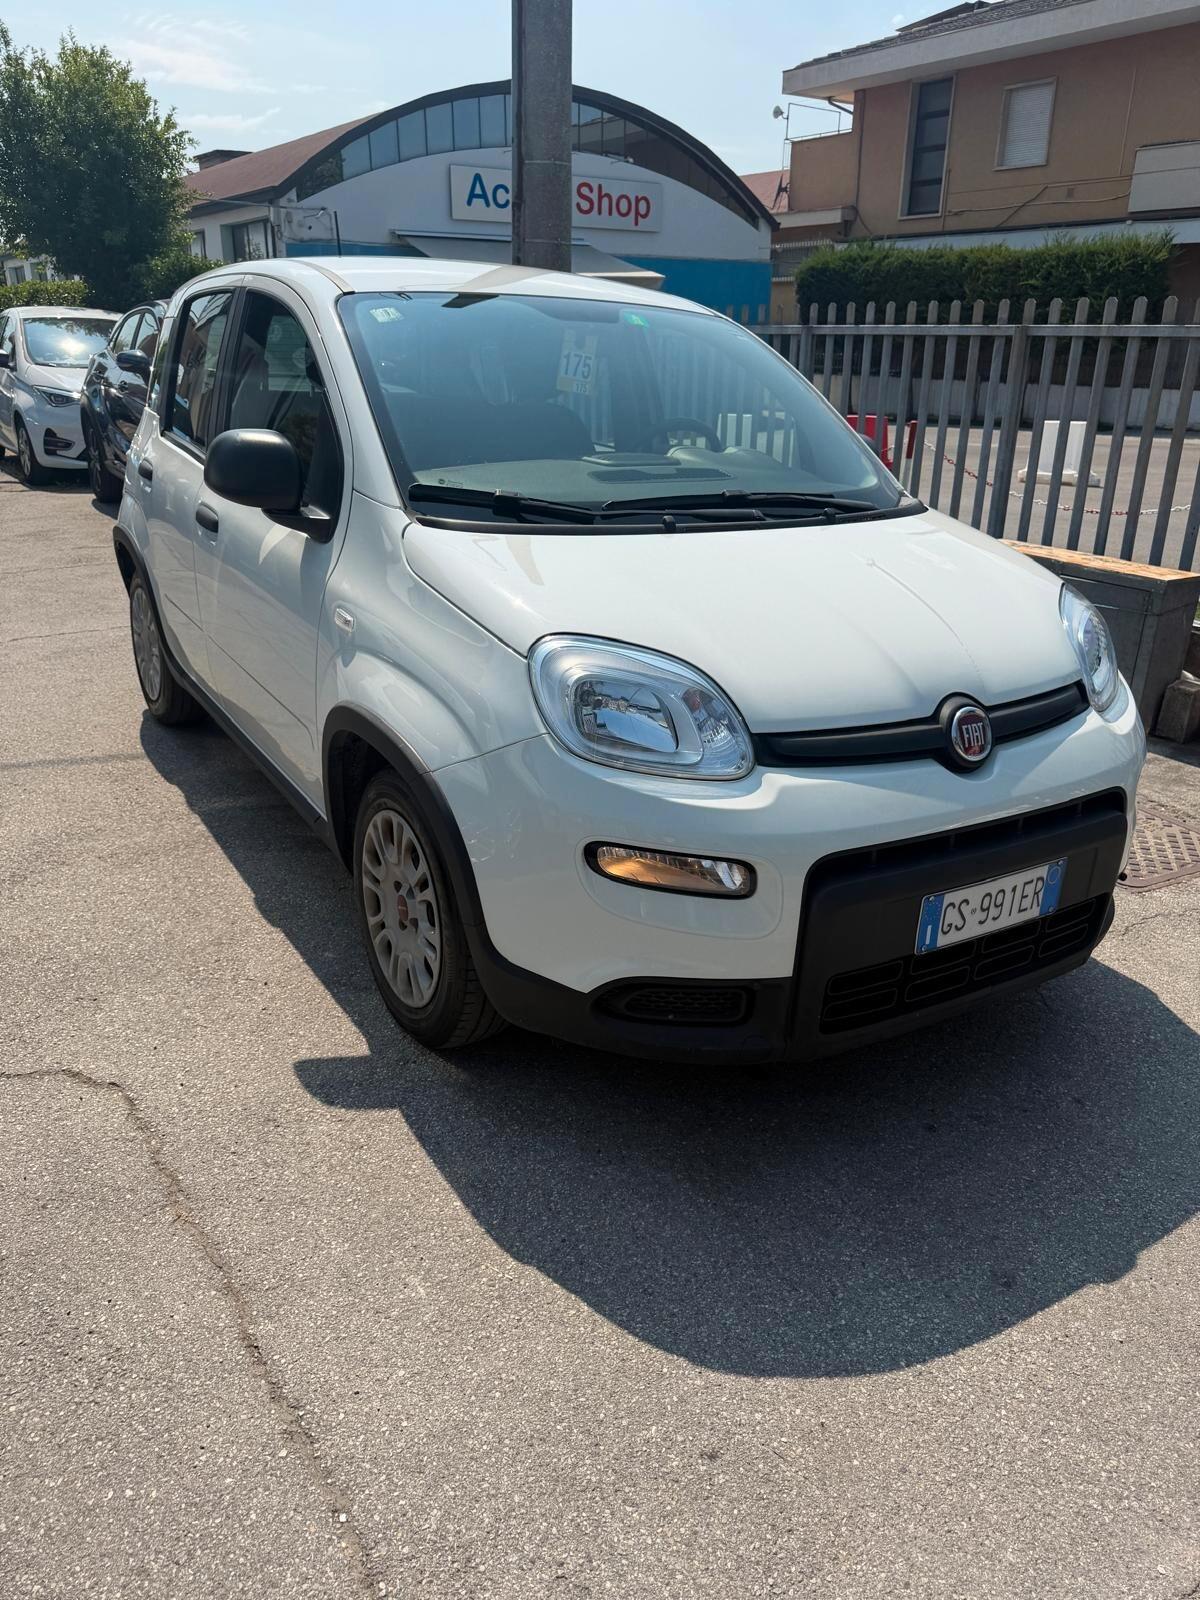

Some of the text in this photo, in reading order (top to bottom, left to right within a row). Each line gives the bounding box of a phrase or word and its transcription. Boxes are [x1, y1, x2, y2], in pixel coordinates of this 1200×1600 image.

[576, 181, 651, 226] Shop
[563, 351, 593, 379] 175
[962, 722, 984, 748] FIAT
